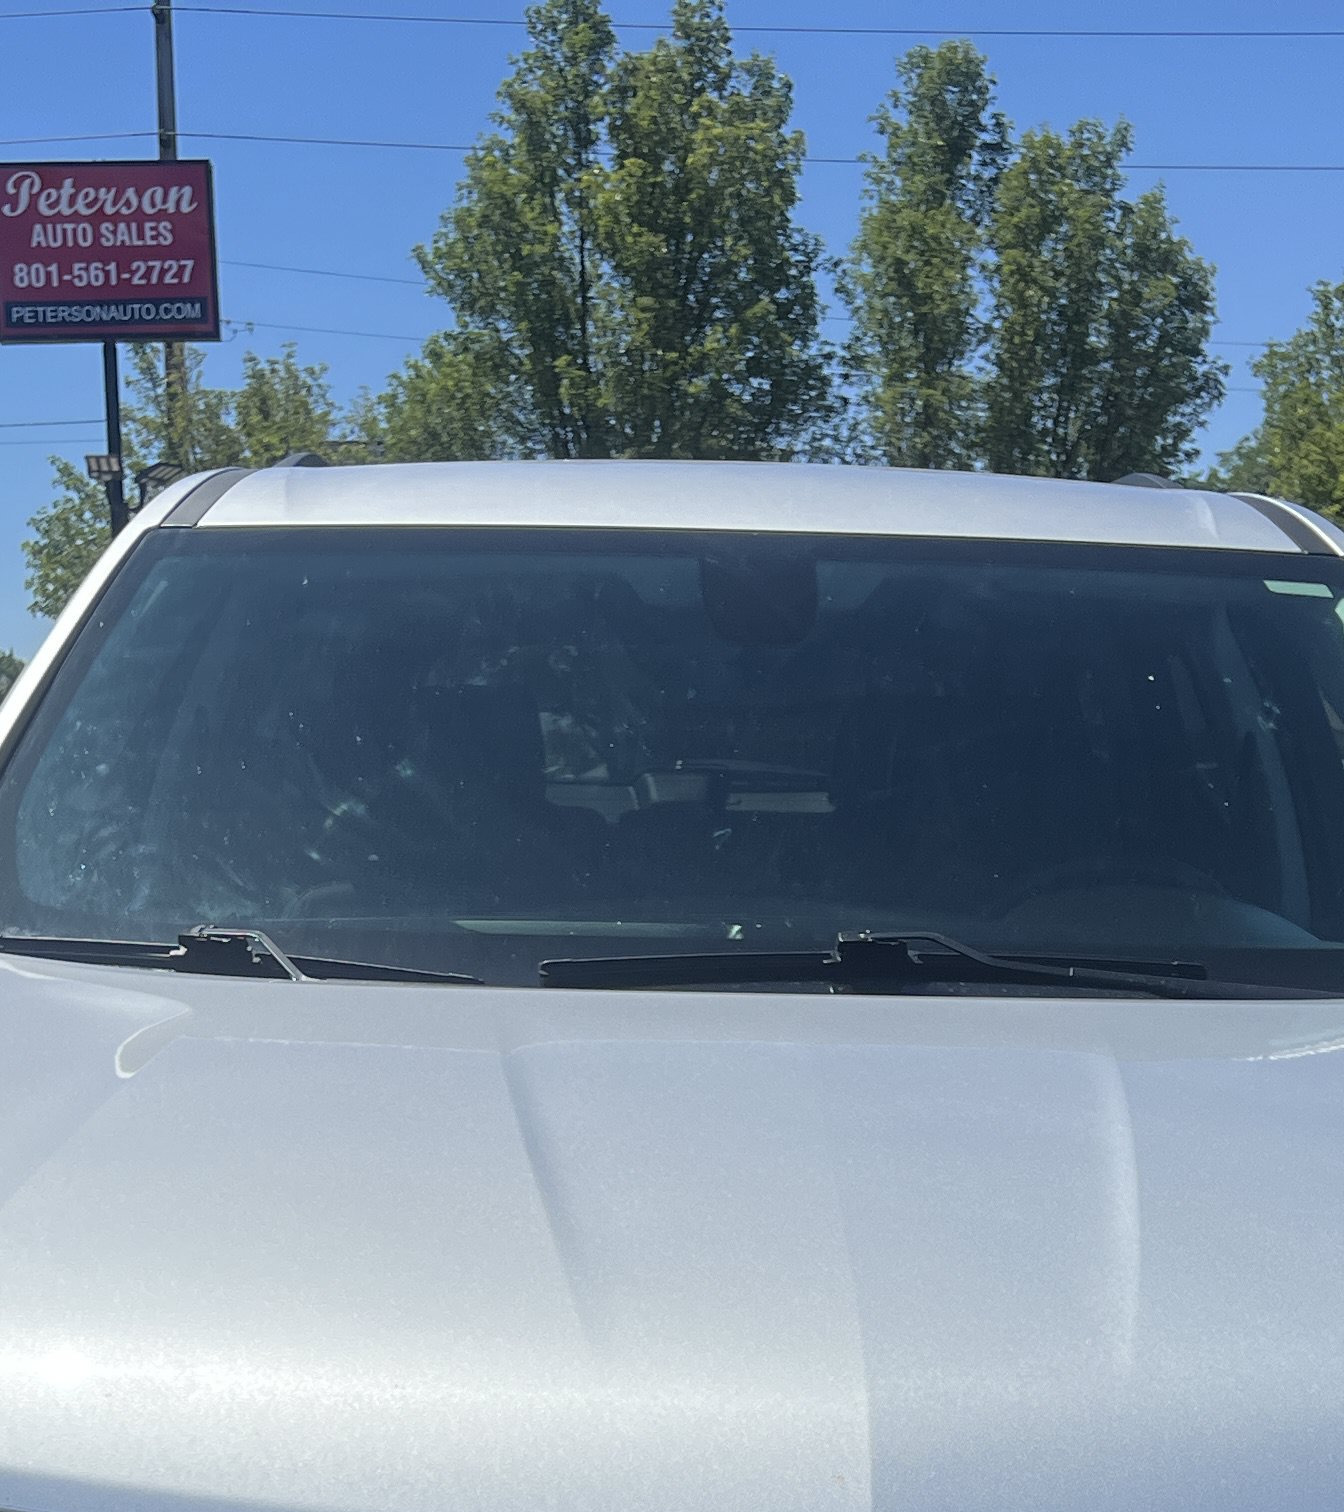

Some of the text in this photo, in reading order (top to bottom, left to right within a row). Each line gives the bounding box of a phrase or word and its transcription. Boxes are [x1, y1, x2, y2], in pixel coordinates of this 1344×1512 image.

[1, 171, 198, 217] Peterson
[30, 221, 173, 248] AUTO SALES
[13, 259, 194, 288] 801-561-2727
[11, 303, 201, 323] PETERSONAUTO.COM
